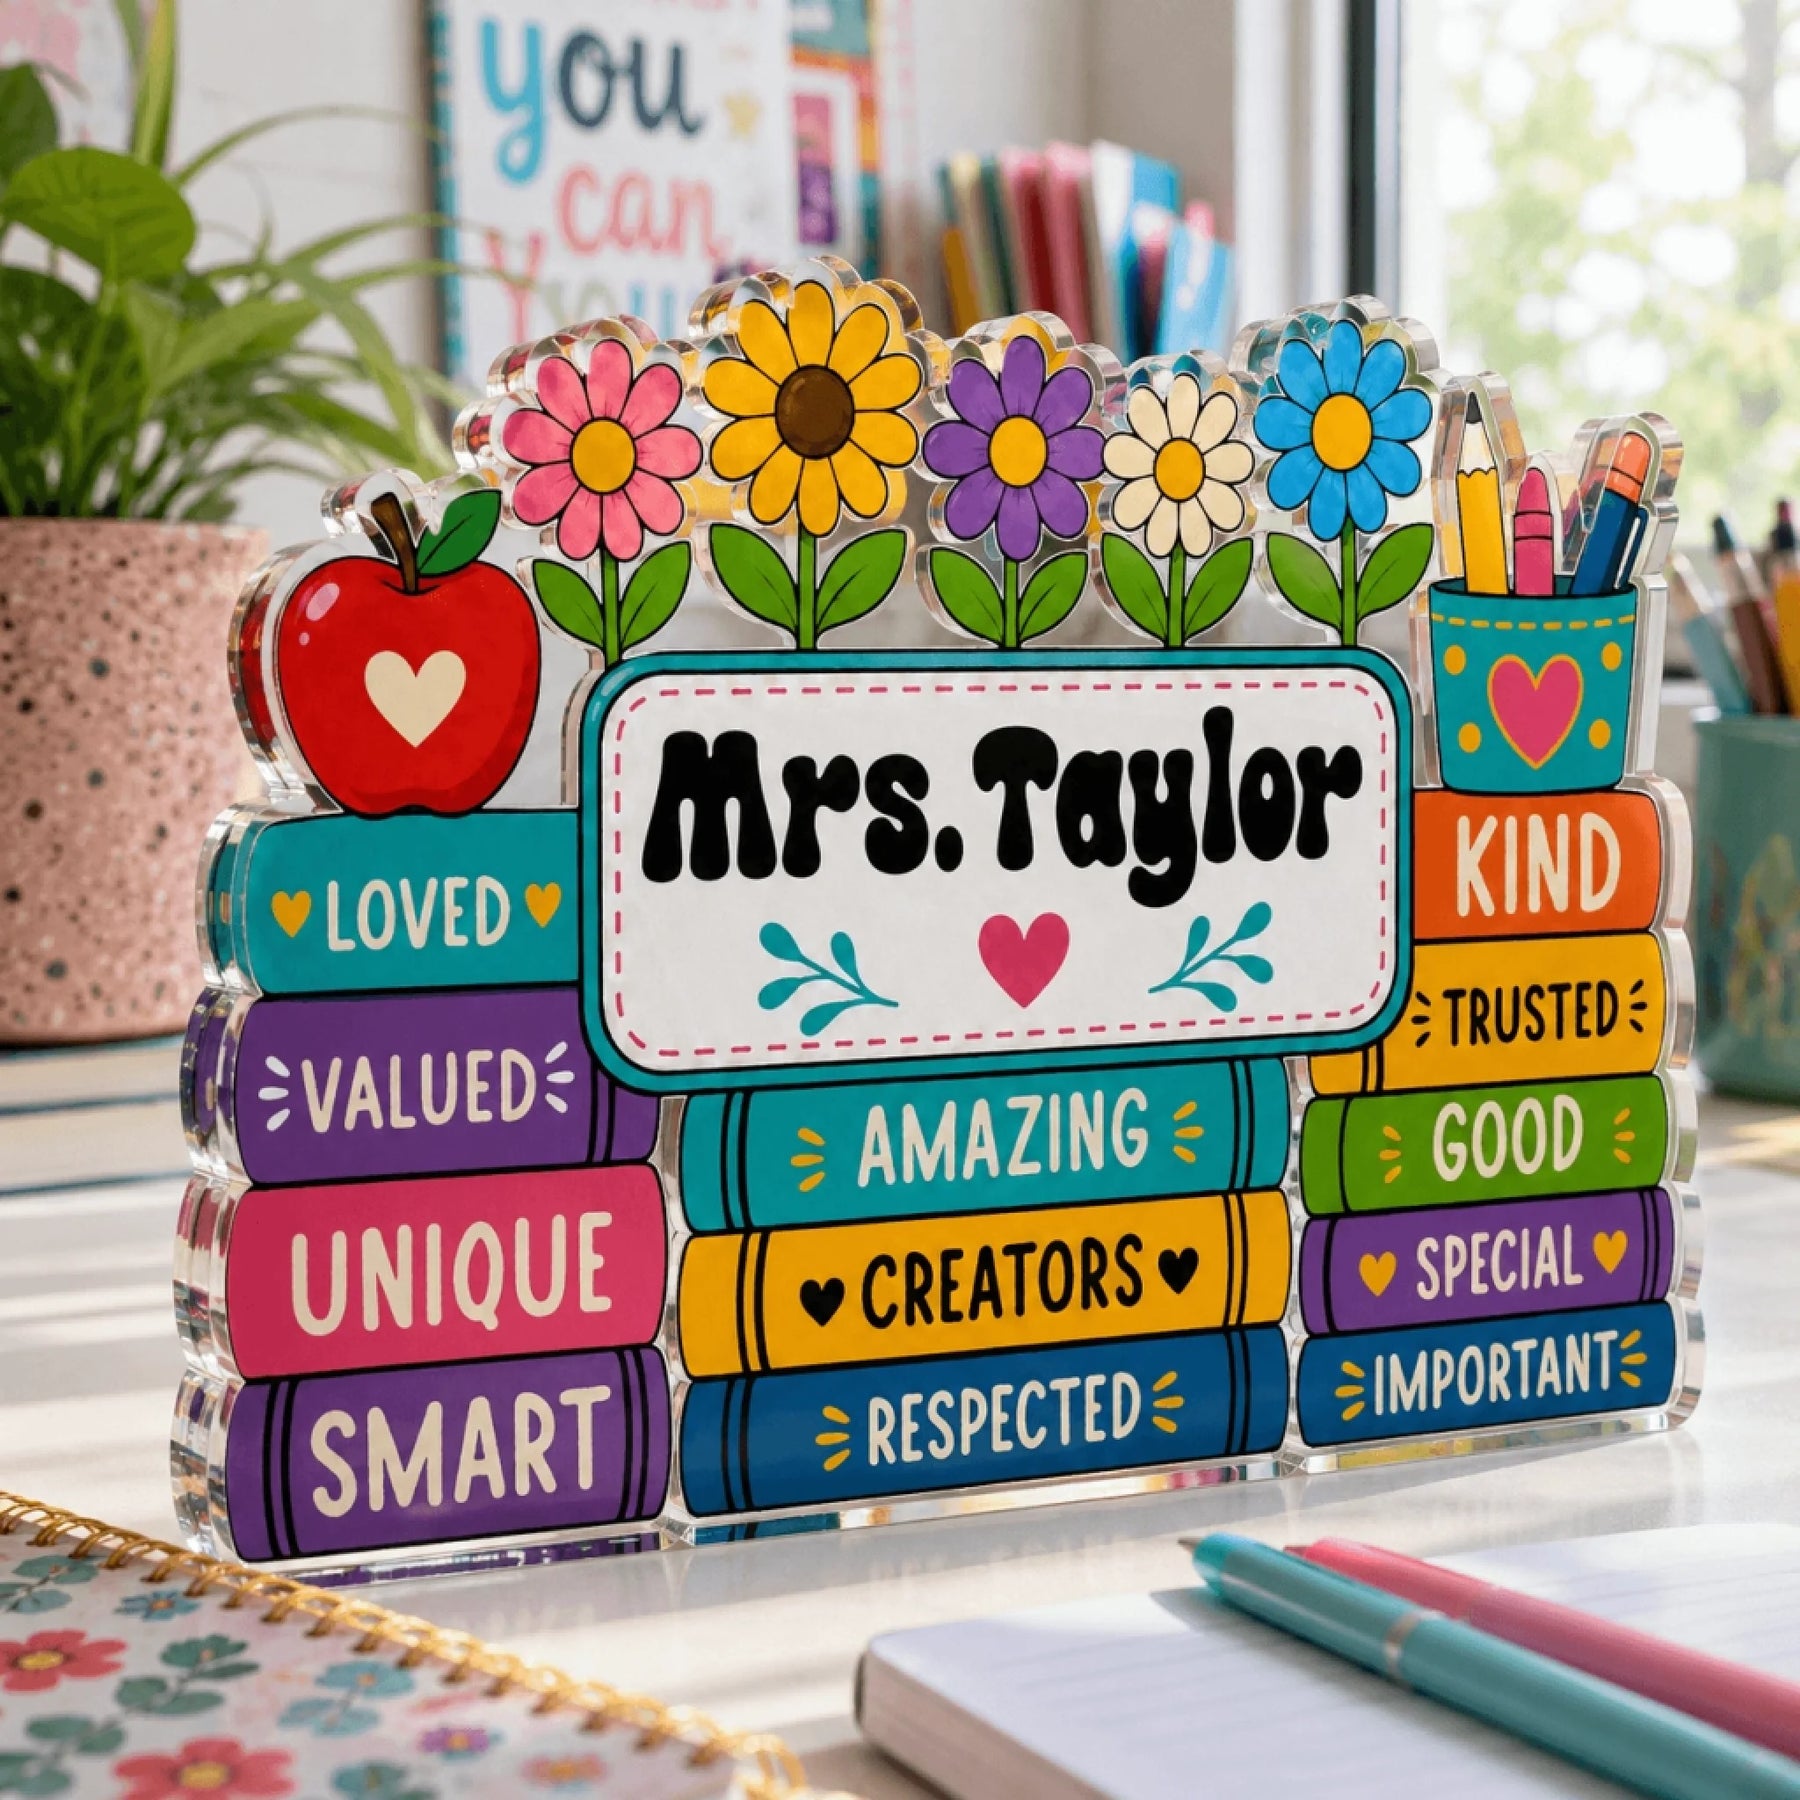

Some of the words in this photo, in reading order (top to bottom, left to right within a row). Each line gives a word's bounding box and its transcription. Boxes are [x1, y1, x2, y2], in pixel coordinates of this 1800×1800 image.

[478, 16, 704, 184] you
[556, 166, 730, 262] can
[642, 731, 964, 882] Mrs.
[973, 706, 1363, 908] Taylor
[329, 875, 510, 950] LOVED
[1457, 813, 1621, 917] KIND
[1442, 981, 1619, 1047] TRUSTED
[302, 1049, 537, 1133] VALUED
[858, 1087, 1149, 1187] AMAZING
[1433, 1095, 1583, 1182] GOOD
[292, 1212, 613, 1335] UNIQUE
[861, 1233, 1143, 1329] CREATORS
[1416, 1225, 1583, 1300] SPECIAL
[869, 1373, 1141, 1466] RESPECTED
[1374, 1331, 1619, 1416] IMPORTANT
[310, 1386, 611, 1518] SMART
